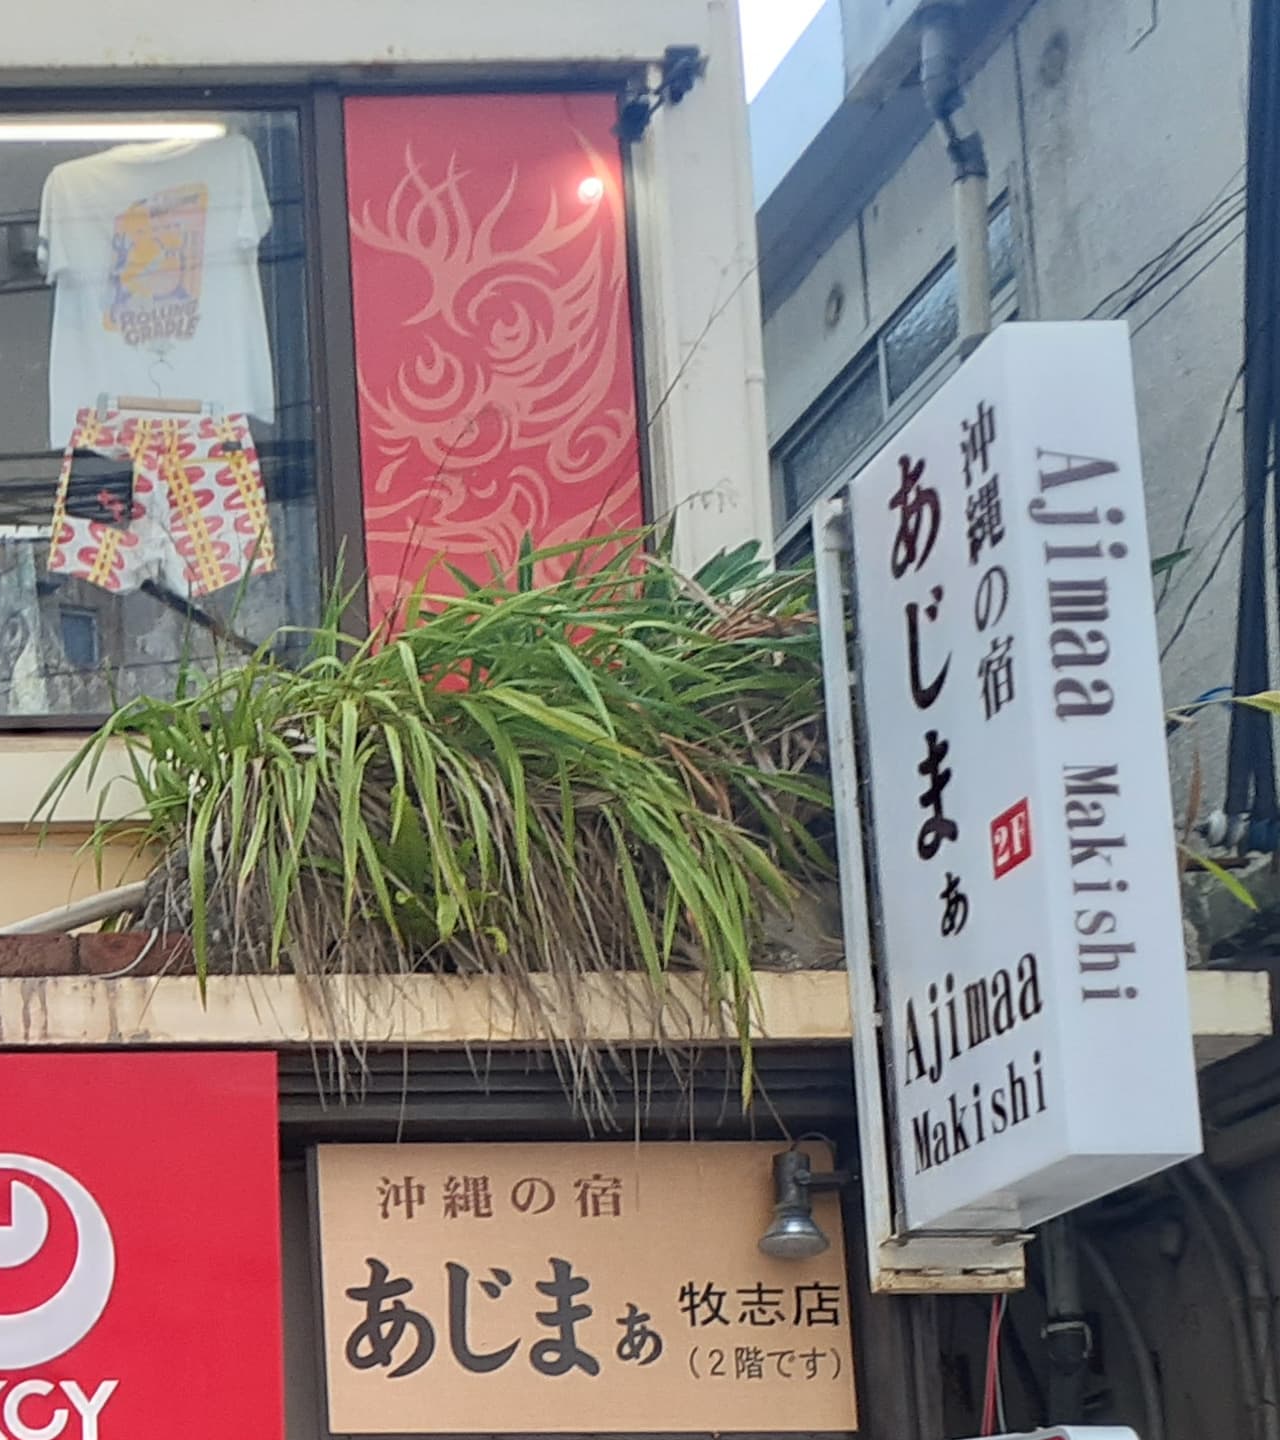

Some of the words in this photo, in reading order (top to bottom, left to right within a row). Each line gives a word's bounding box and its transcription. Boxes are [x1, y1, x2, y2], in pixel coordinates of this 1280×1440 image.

[960, 400, 1017, 721] 沖縄の宿
[1027, 446, 1129, 722] Ajimaa
[994, 808, 1029, 869] 2F
[1061, 763, 1139, 1003] Makishi
[904, 950, 1042, 1087] Ajimaa
[912, 1051, 1047, 1177] Makishi
[377, 1173, 623, 1220] 沖縄の宿
[678, 1281, 840, 1327] 牧志店
